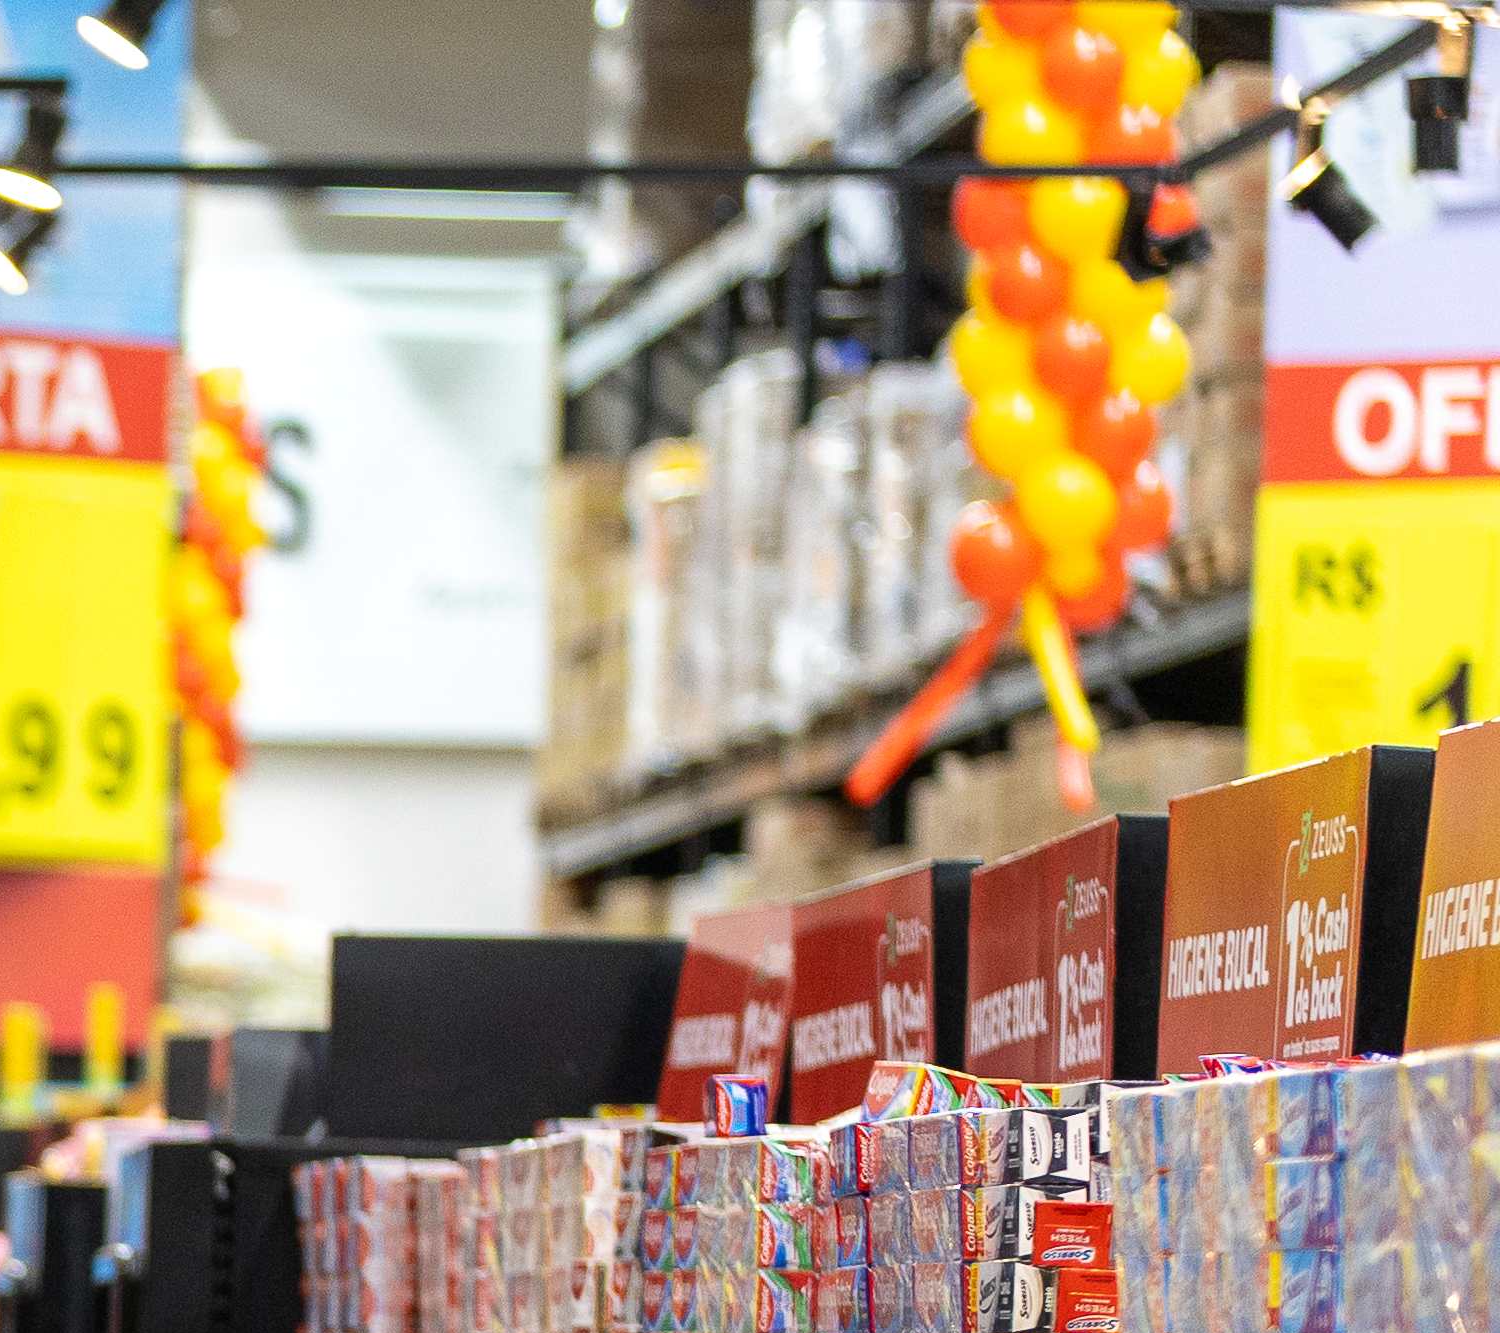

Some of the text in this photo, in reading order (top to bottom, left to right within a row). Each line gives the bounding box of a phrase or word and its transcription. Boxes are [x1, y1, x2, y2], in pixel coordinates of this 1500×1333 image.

[1293, 543, 1380, 611] R$
[1311, 814, 1347, 860] ZEUSS
[1315, 893, 1349, 956] Cash
[1421, 884, 1488, 959] HIGIENE
[1167, 924, 1270, 999] HIGIENE BUCAL
[970, 976, 1049, 1058] HIGIENE BUCAL
[1310, 962, 1343, 1022] back
[965, 1126, 974, 1177] Colgate
[966, 1202, 974, 1252] Colgate
[1051, 1232, 1090, 1244] FRESH
[1043, 1249, 1094, 1261] SORRISO
[1075, 1303, 1116, 1314] FRESH
